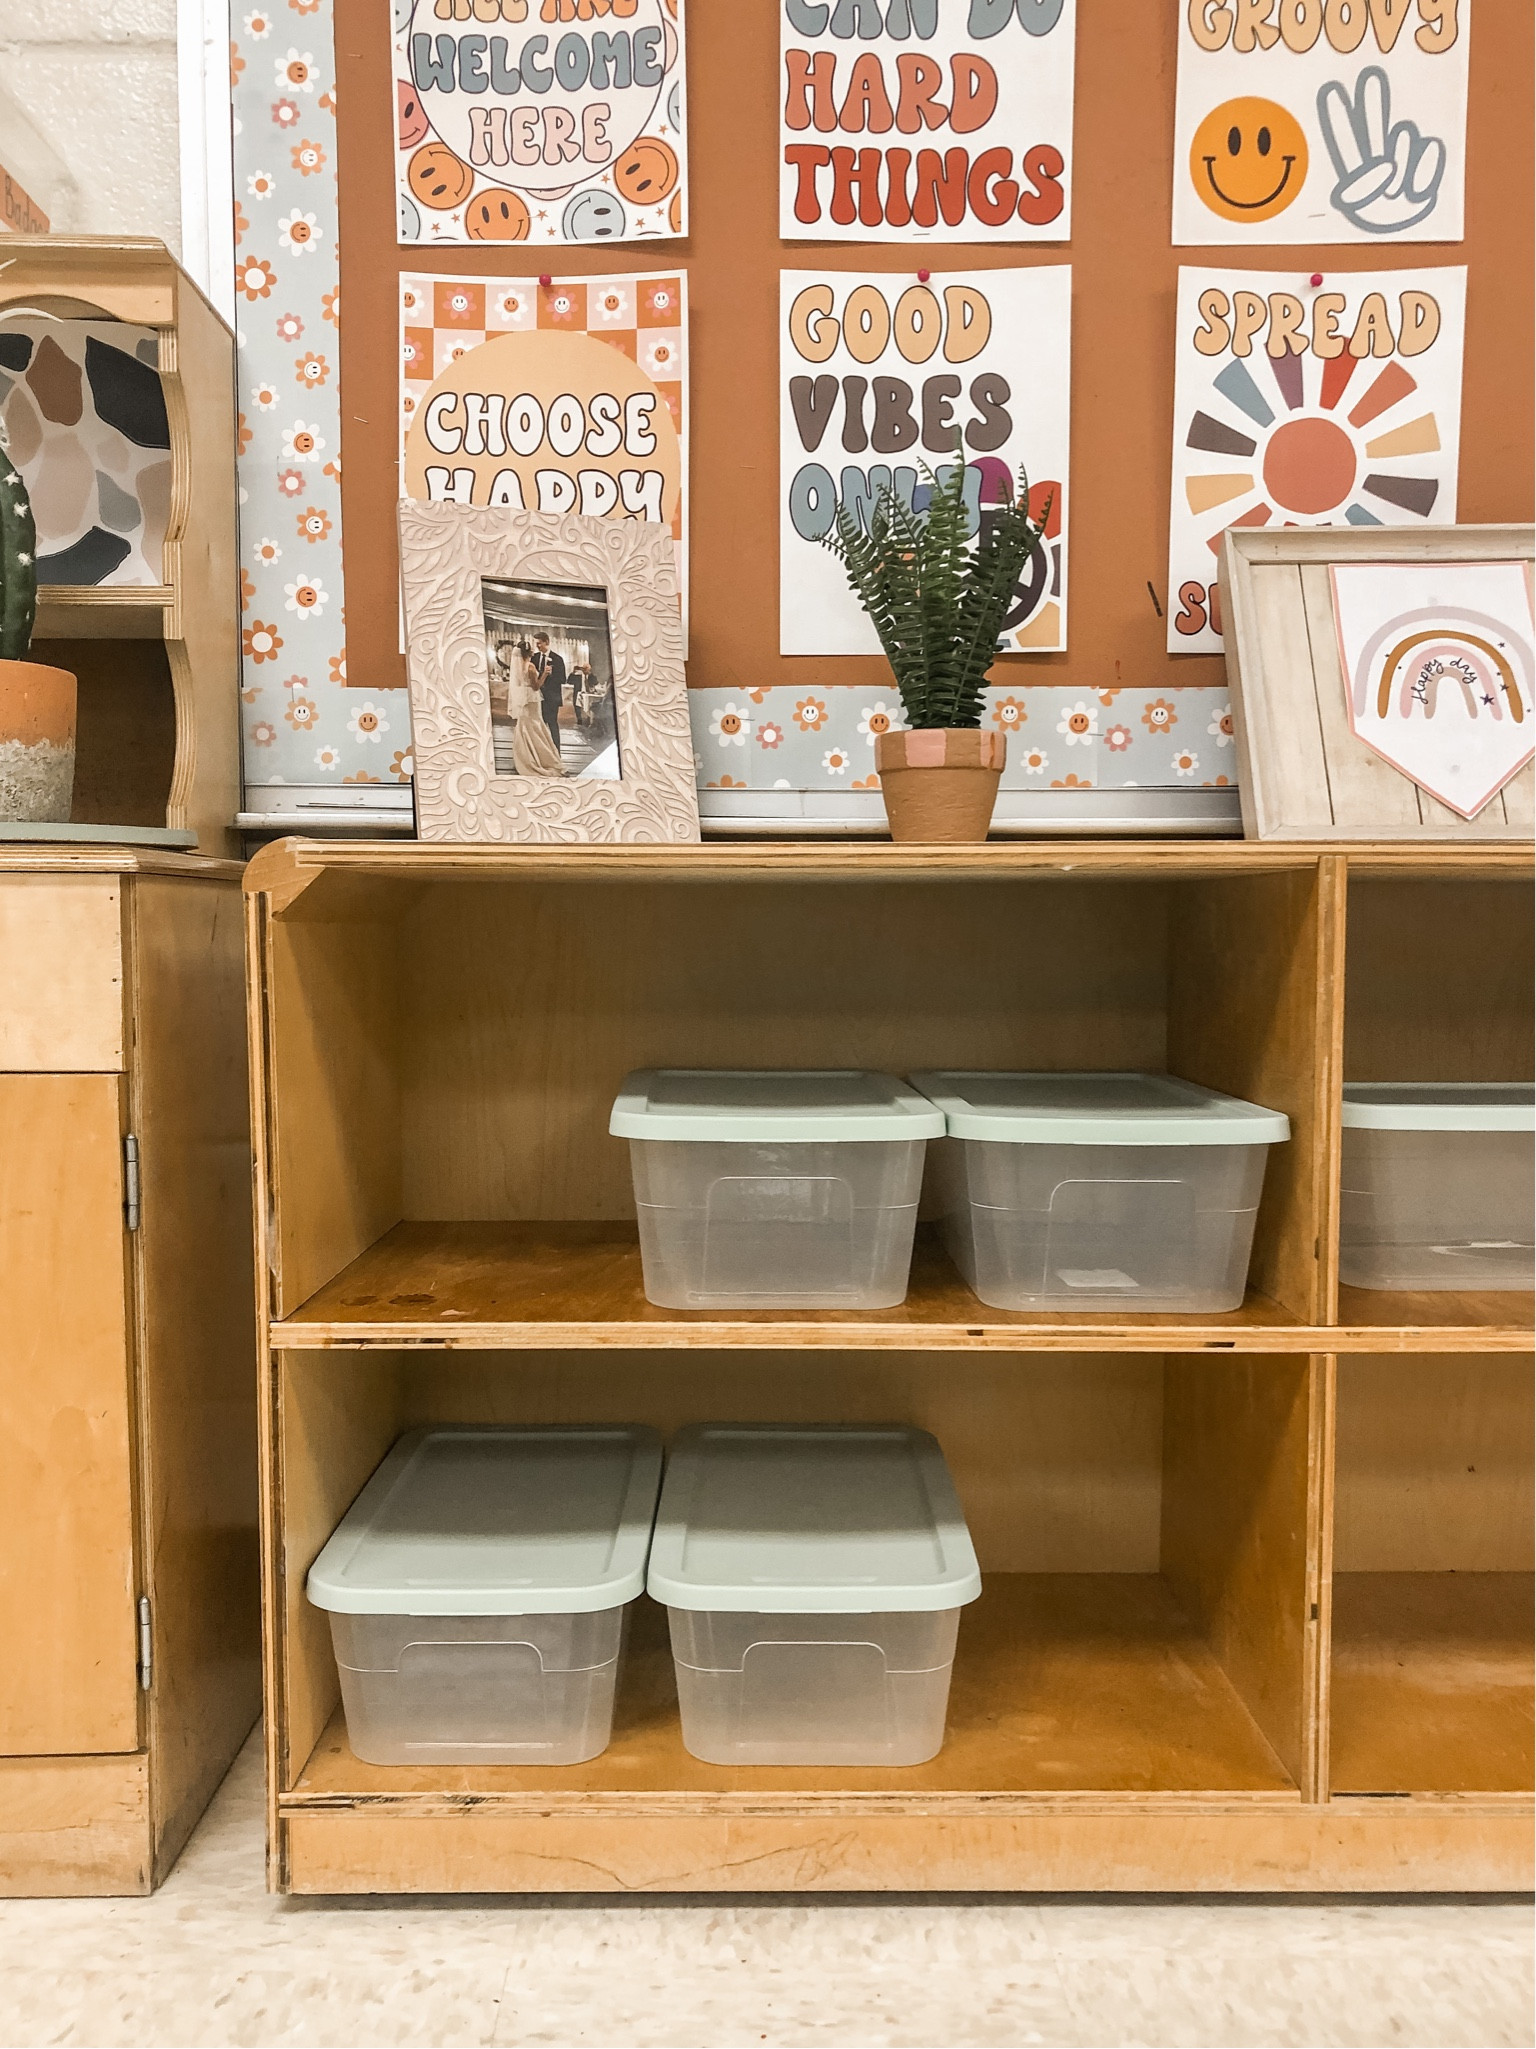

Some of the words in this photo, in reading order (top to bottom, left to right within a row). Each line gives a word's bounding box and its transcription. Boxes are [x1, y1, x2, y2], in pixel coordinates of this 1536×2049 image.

[413, 26, 664, 95] WELCOME
[1188, 0, 1458, 54] GROOVY
[785, 49, 998, 134] HARD
[469, 103, 612, 166] HERE
[785, 144, 1064, 227] THINGS
[789, 284, 992, 363] GOOD
[1193, 288, 1441, 359] SPREAD
[425, 392, 657, 457] CHOOSE
[789, 373, 1013, 453] VIBES
[1449, 658, 1478, 685] day
